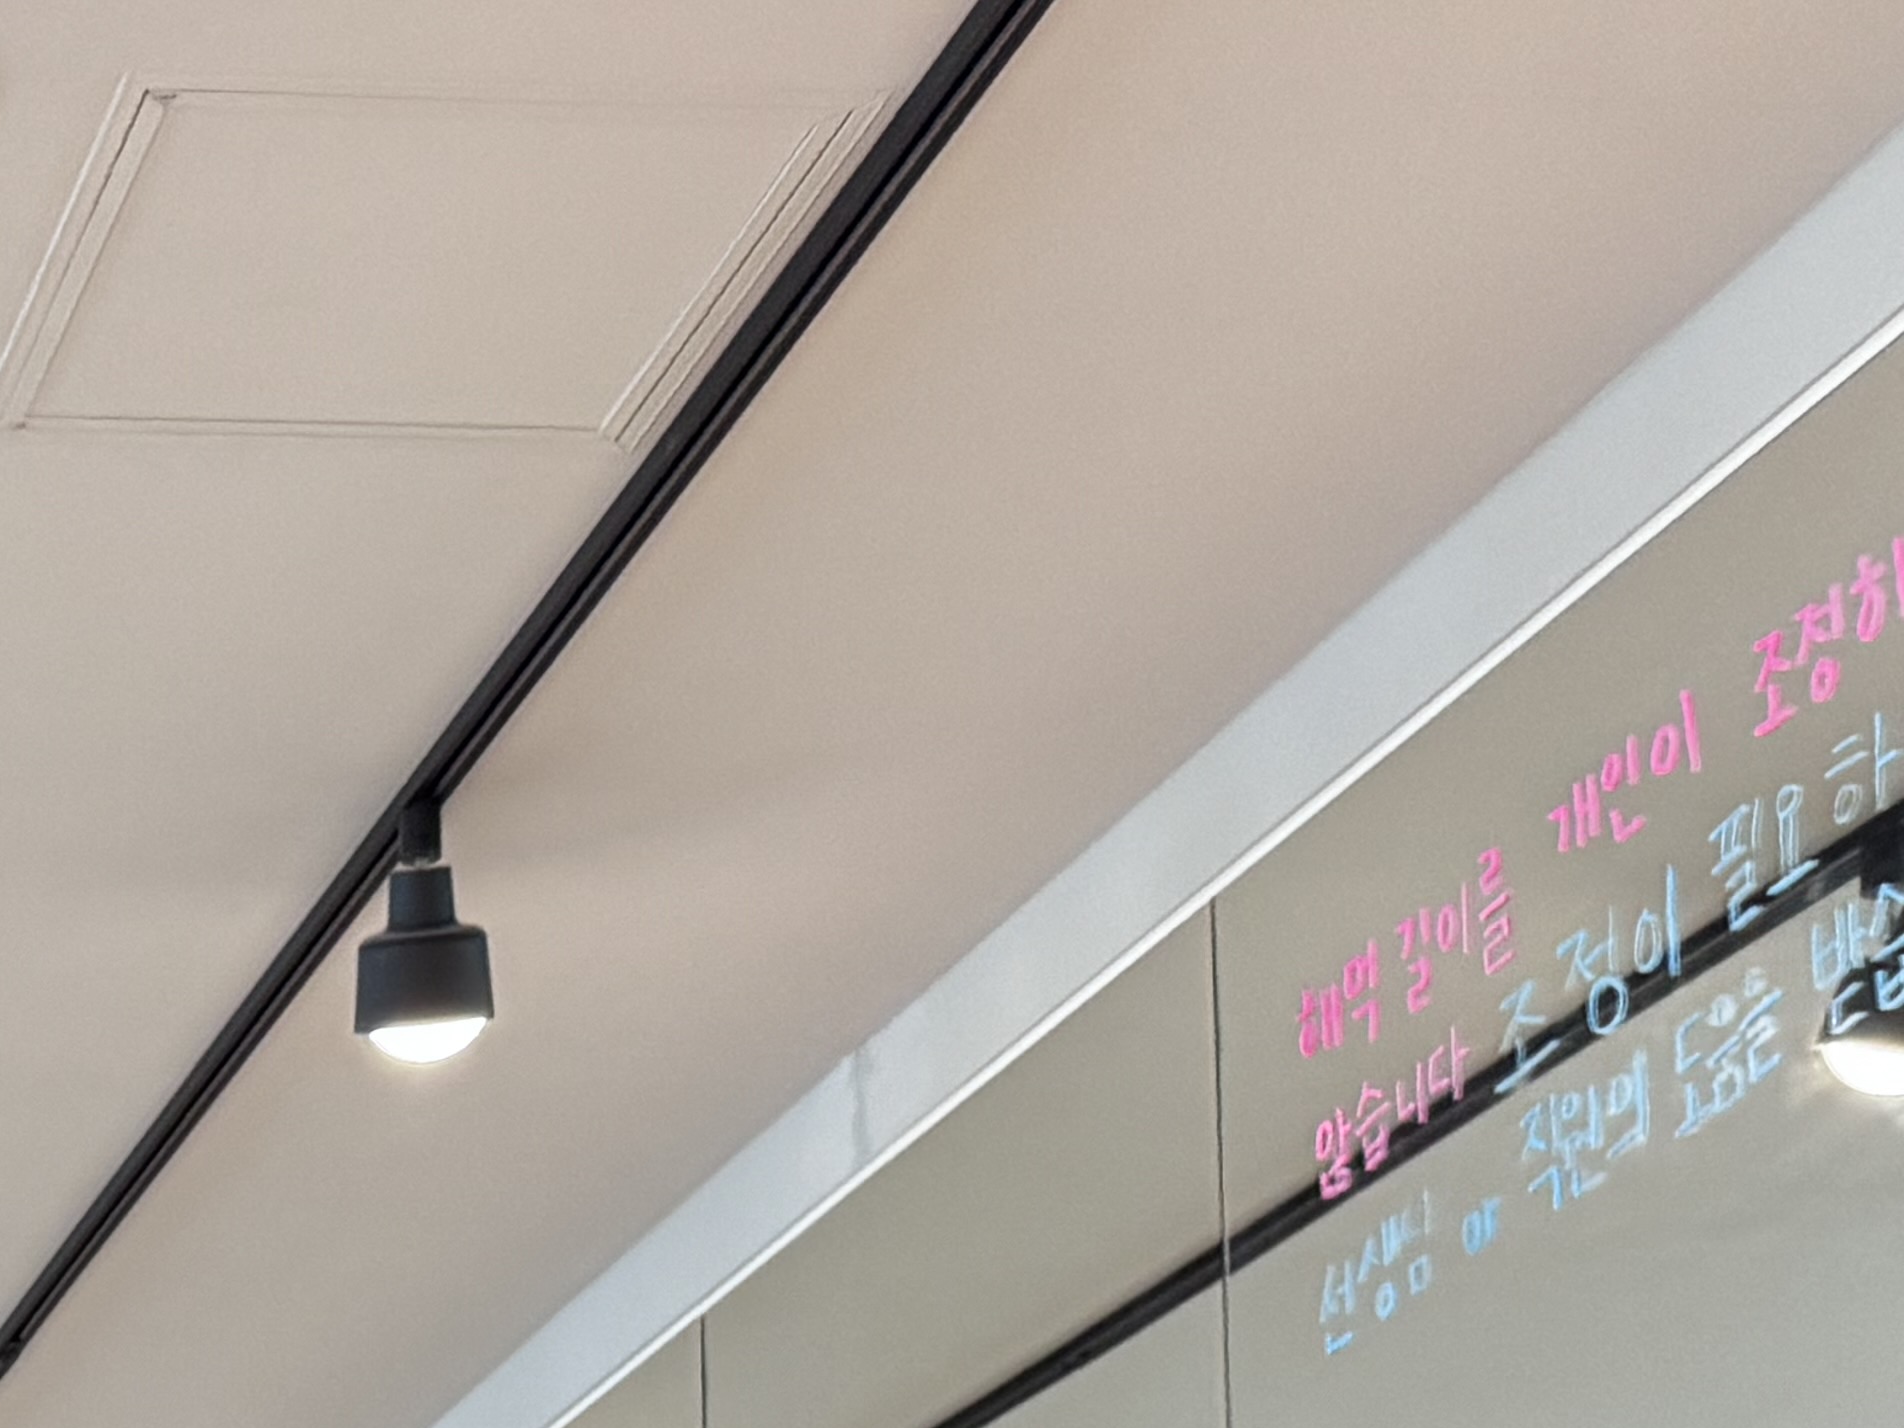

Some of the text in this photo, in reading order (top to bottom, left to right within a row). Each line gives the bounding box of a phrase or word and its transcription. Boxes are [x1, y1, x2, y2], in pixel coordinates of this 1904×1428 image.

[1297, 938, 1381, 1059] 해먹
[1396, 848, 1517, 1014] 길이를
[1547, 690, 1702, 852] 개인이
[1315, 1024, 1470, 1200] 않습니다
[1494, 865, 1682, 1093] 조정이
[1319, 1189, 1433, 1356] 선생님
